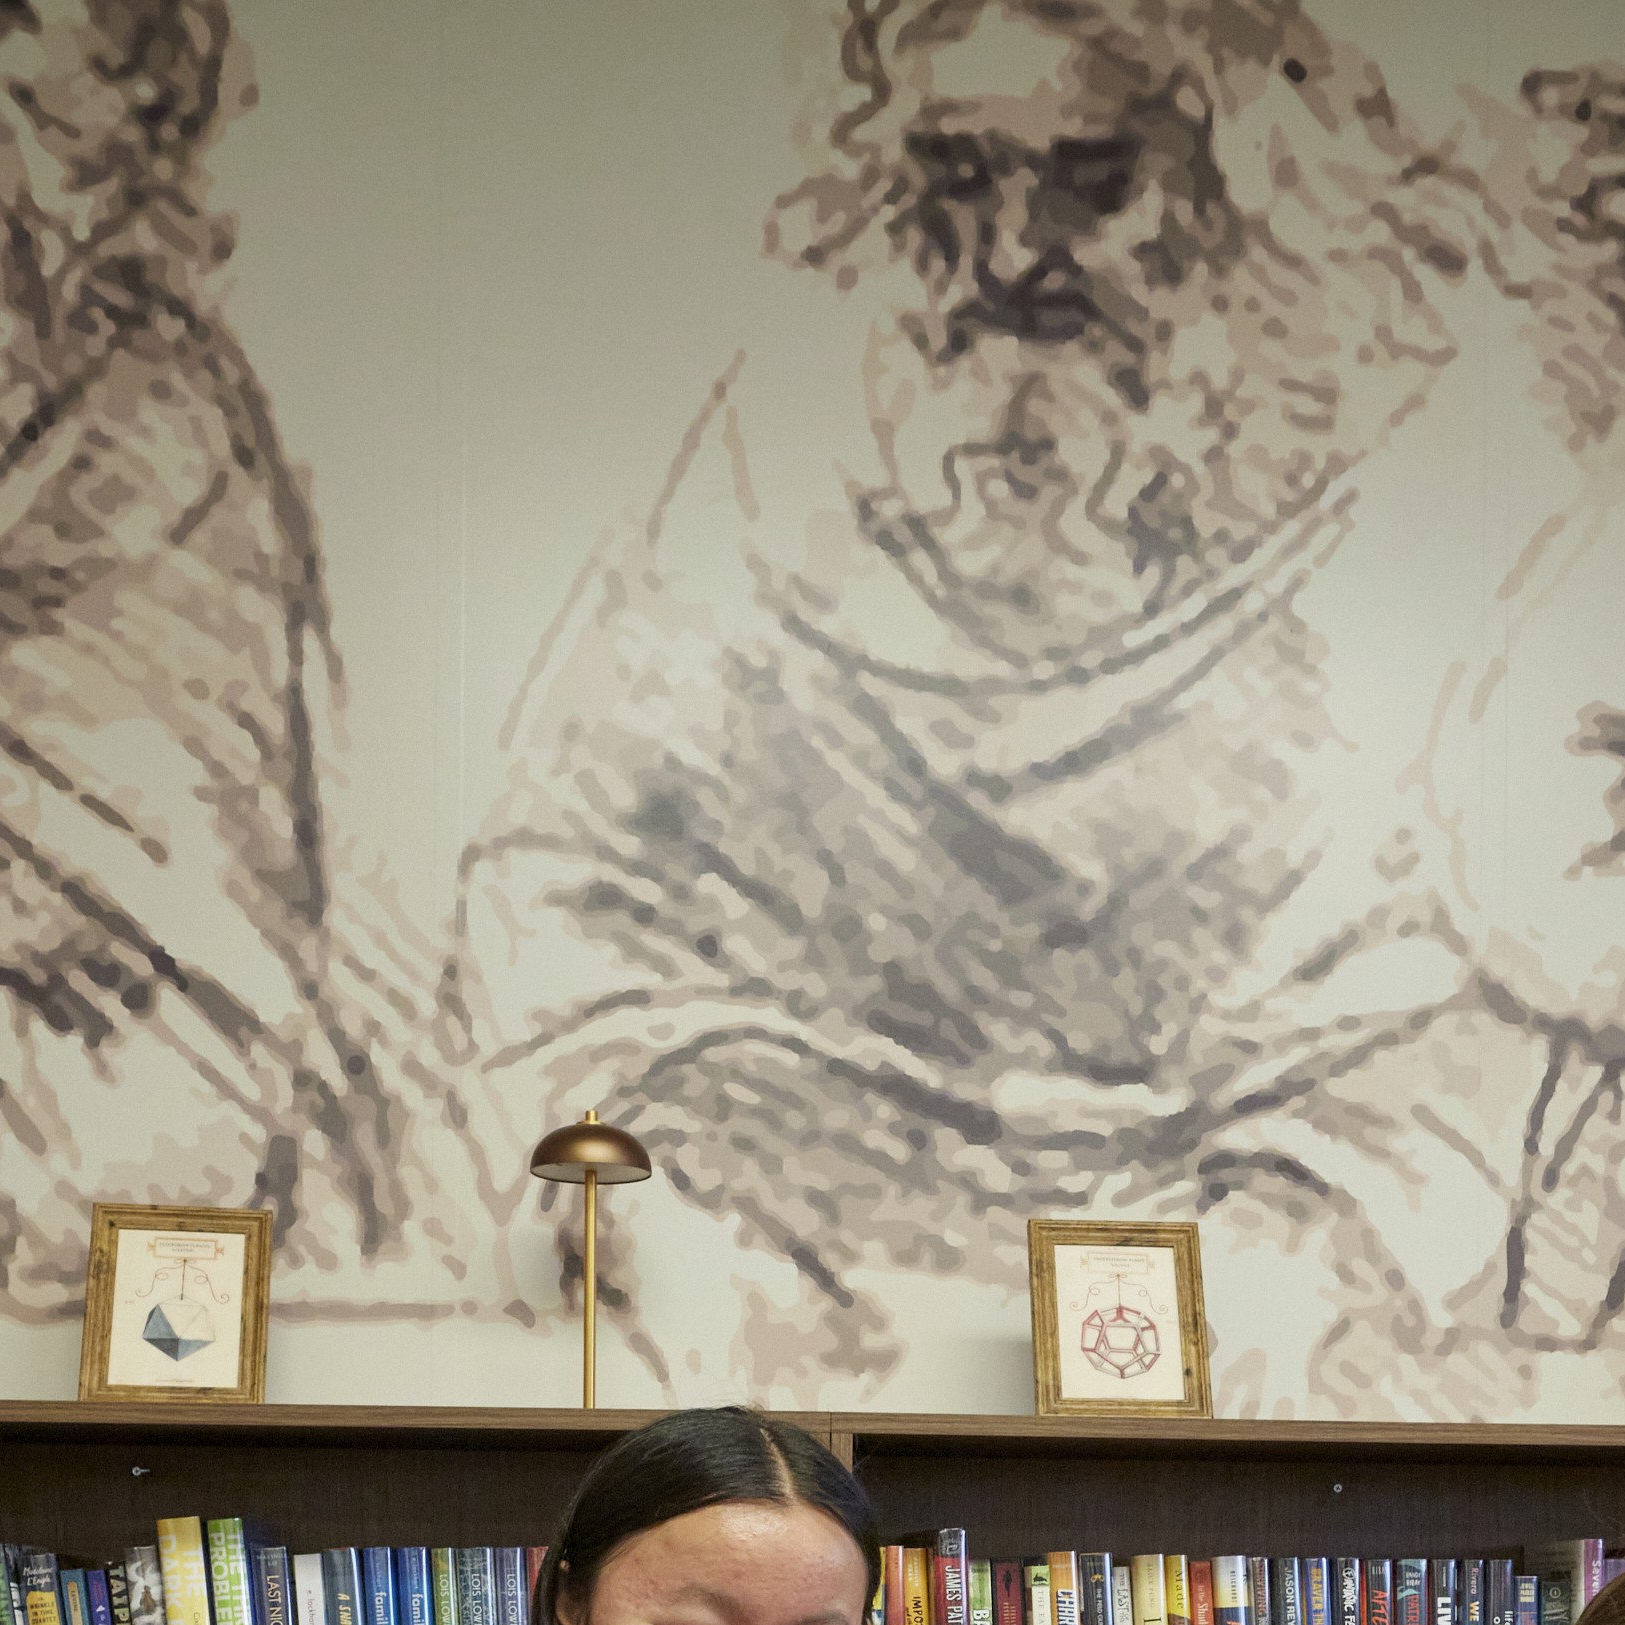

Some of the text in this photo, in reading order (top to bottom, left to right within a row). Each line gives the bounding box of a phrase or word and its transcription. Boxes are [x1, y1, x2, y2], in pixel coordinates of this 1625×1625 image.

[267, 1575, 282, 1604] LAST
[439, 1574, 450, 1597] LOIS
[472, 1574, 482, 1596] LOIS
[945, 1566, 962, 1600] JAMES
[1283, 1568, 1294, 1603] JASON
[1469, 1601, 1480, 1621] WE
